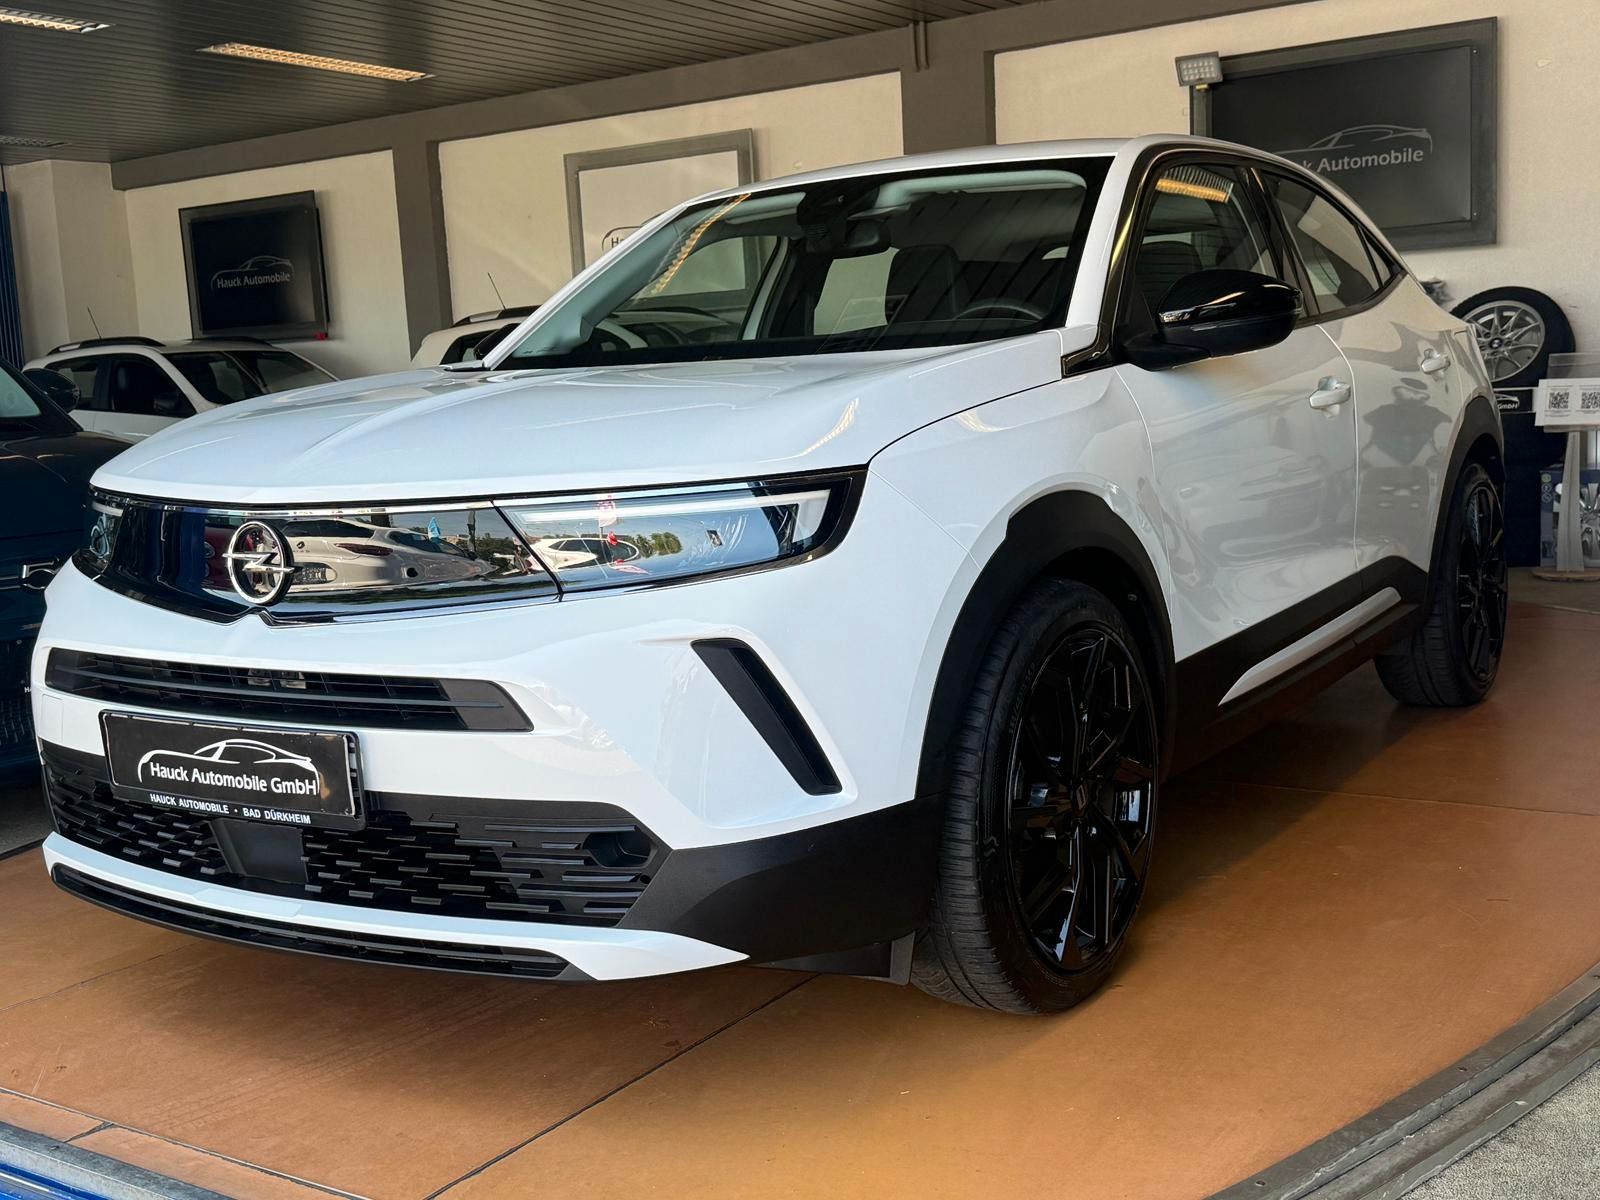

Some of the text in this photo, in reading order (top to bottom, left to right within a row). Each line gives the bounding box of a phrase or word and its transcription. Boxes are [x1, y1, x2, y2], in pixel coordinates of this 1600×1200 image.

[1317, 148, 1423, 172] Automobile
[217, 271, 291, 289] Hauck Automobile
[150, 762, 317, 796] Hauck Automobile GmbH
[150, 794, 311, 824] HAUCK AUTOMOBILE BAD DÜRKHEIM
